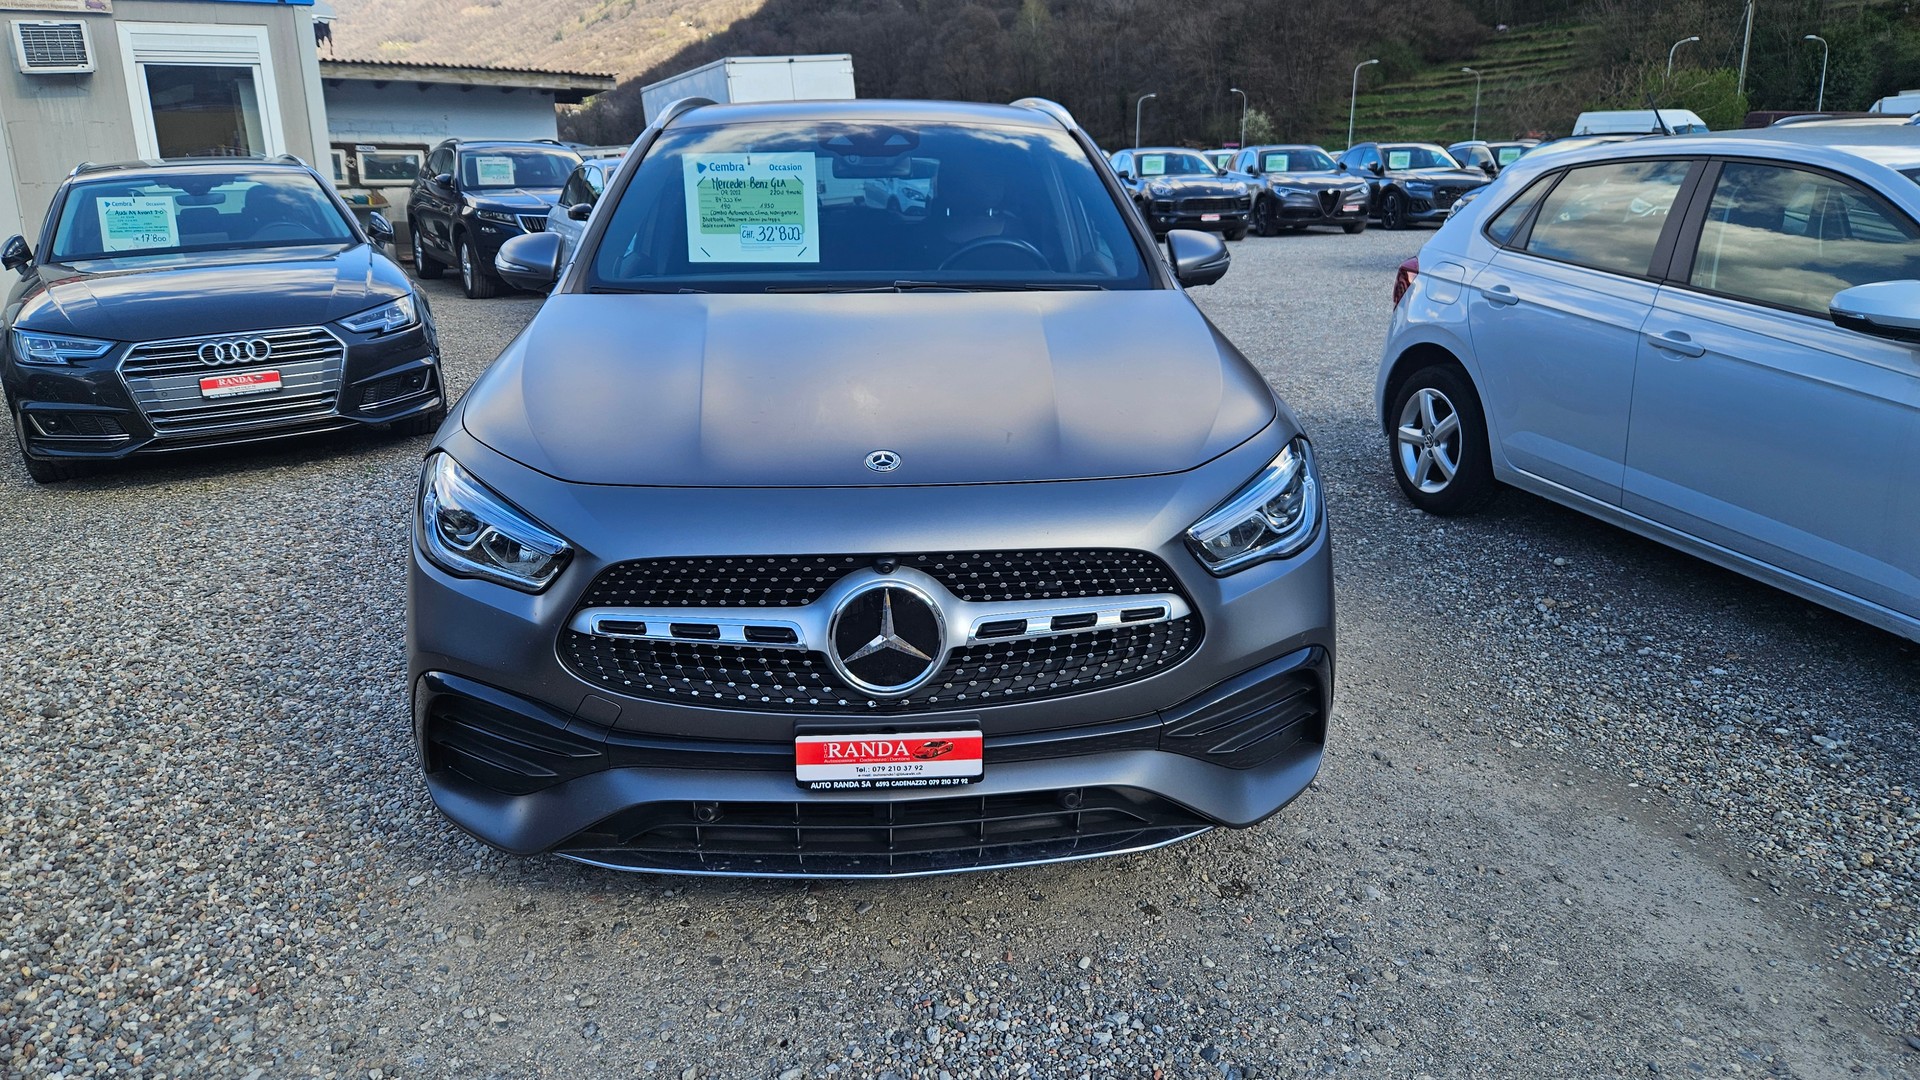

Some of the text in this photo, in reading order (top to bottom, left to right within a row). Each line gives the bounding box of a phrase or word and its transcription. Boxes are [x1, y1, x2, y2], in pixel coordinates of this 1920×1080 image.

[709, 162, 802, 171] Cembra Occasion
[770, 177, 787, 190] GLA
[141, 233, 167, 242] 17'800
[756, 225, 800, 242] 32'800
[218, 376, 254, 386] RANDA
[828, 740, 910, 758] RANDA
[872, 765, 885, 773] 079
[810, 781, 832, 790] AUTO
[833, 781, 860, 789] RANDA
[861, 780, 872, 788] SA
[875, 780, 890, 788] 6593
[891, 779, 927, 787] CADENAZZO
